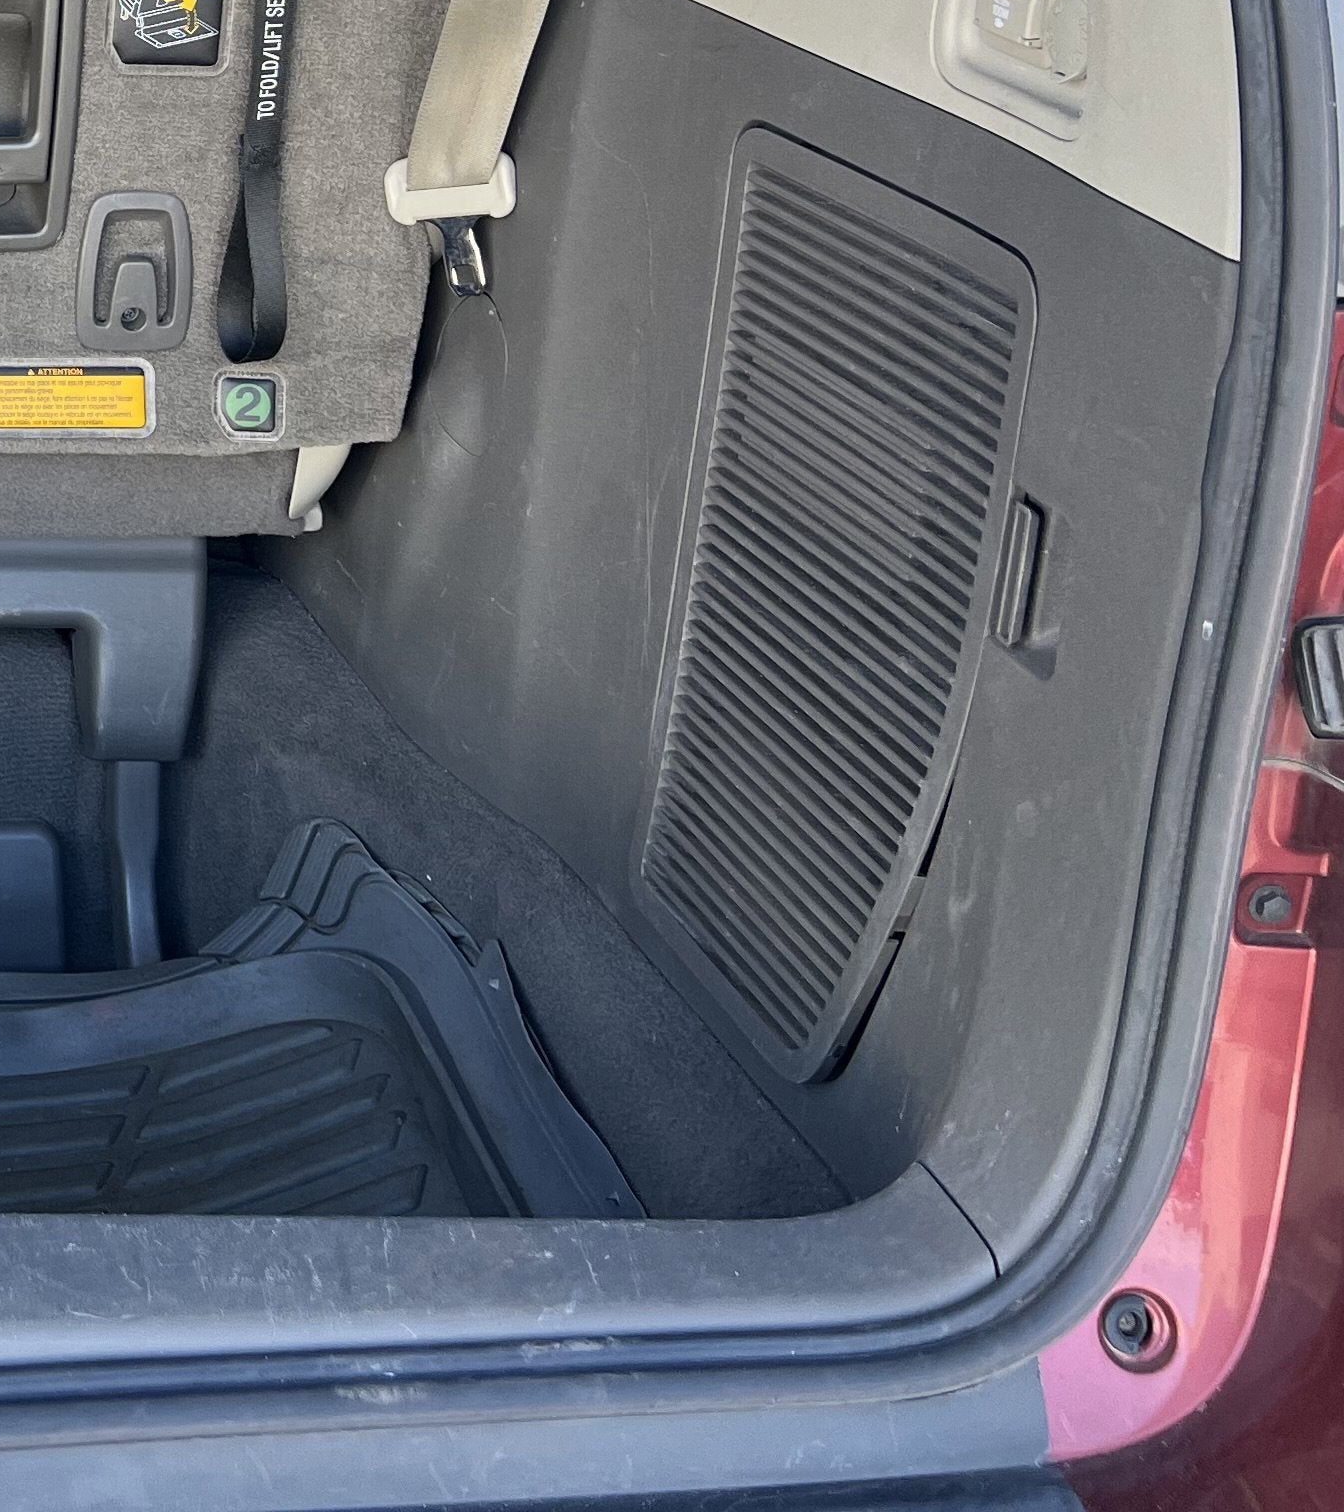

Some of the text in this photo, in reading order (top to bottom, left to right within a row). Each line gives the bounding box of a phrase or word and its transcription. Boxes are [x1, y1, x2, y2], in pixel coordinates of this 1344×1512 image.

[259, 21, 283, 98] FOLD/LIFT
[257, 100, 276, 120] TO
[235, 387, 261, 422] 2
